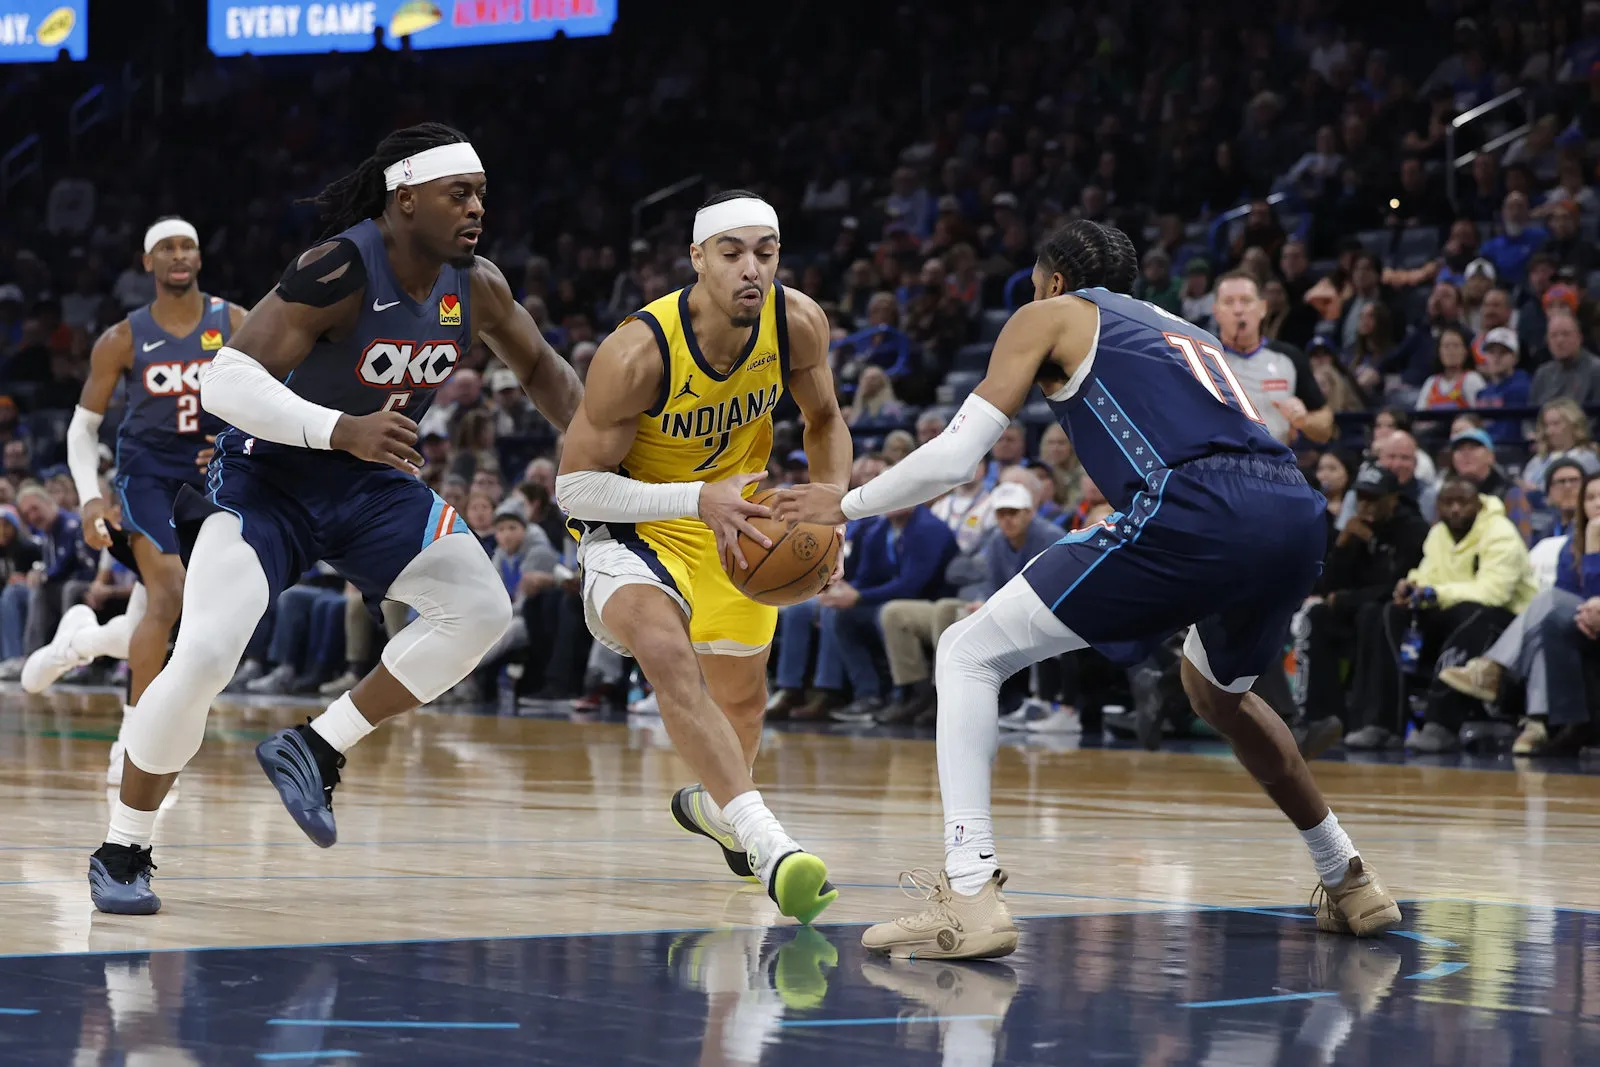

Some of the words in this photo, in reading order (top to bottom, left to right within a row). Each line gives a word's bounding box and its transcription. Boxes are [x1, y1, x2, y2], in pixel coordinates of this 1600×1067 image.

[226, 5, 300, 39] EVERY
[306, 2, 376, 36] GAME
[357, 340, 460, 388] OKC
[746, 357, 766, 371] LUCAS
[1162, 331, 1265, 425] 11
[177, 393, 199, 433] 2
[661, 383, 779, 438] INDIANA
[692, 431, 731, 473] 2
